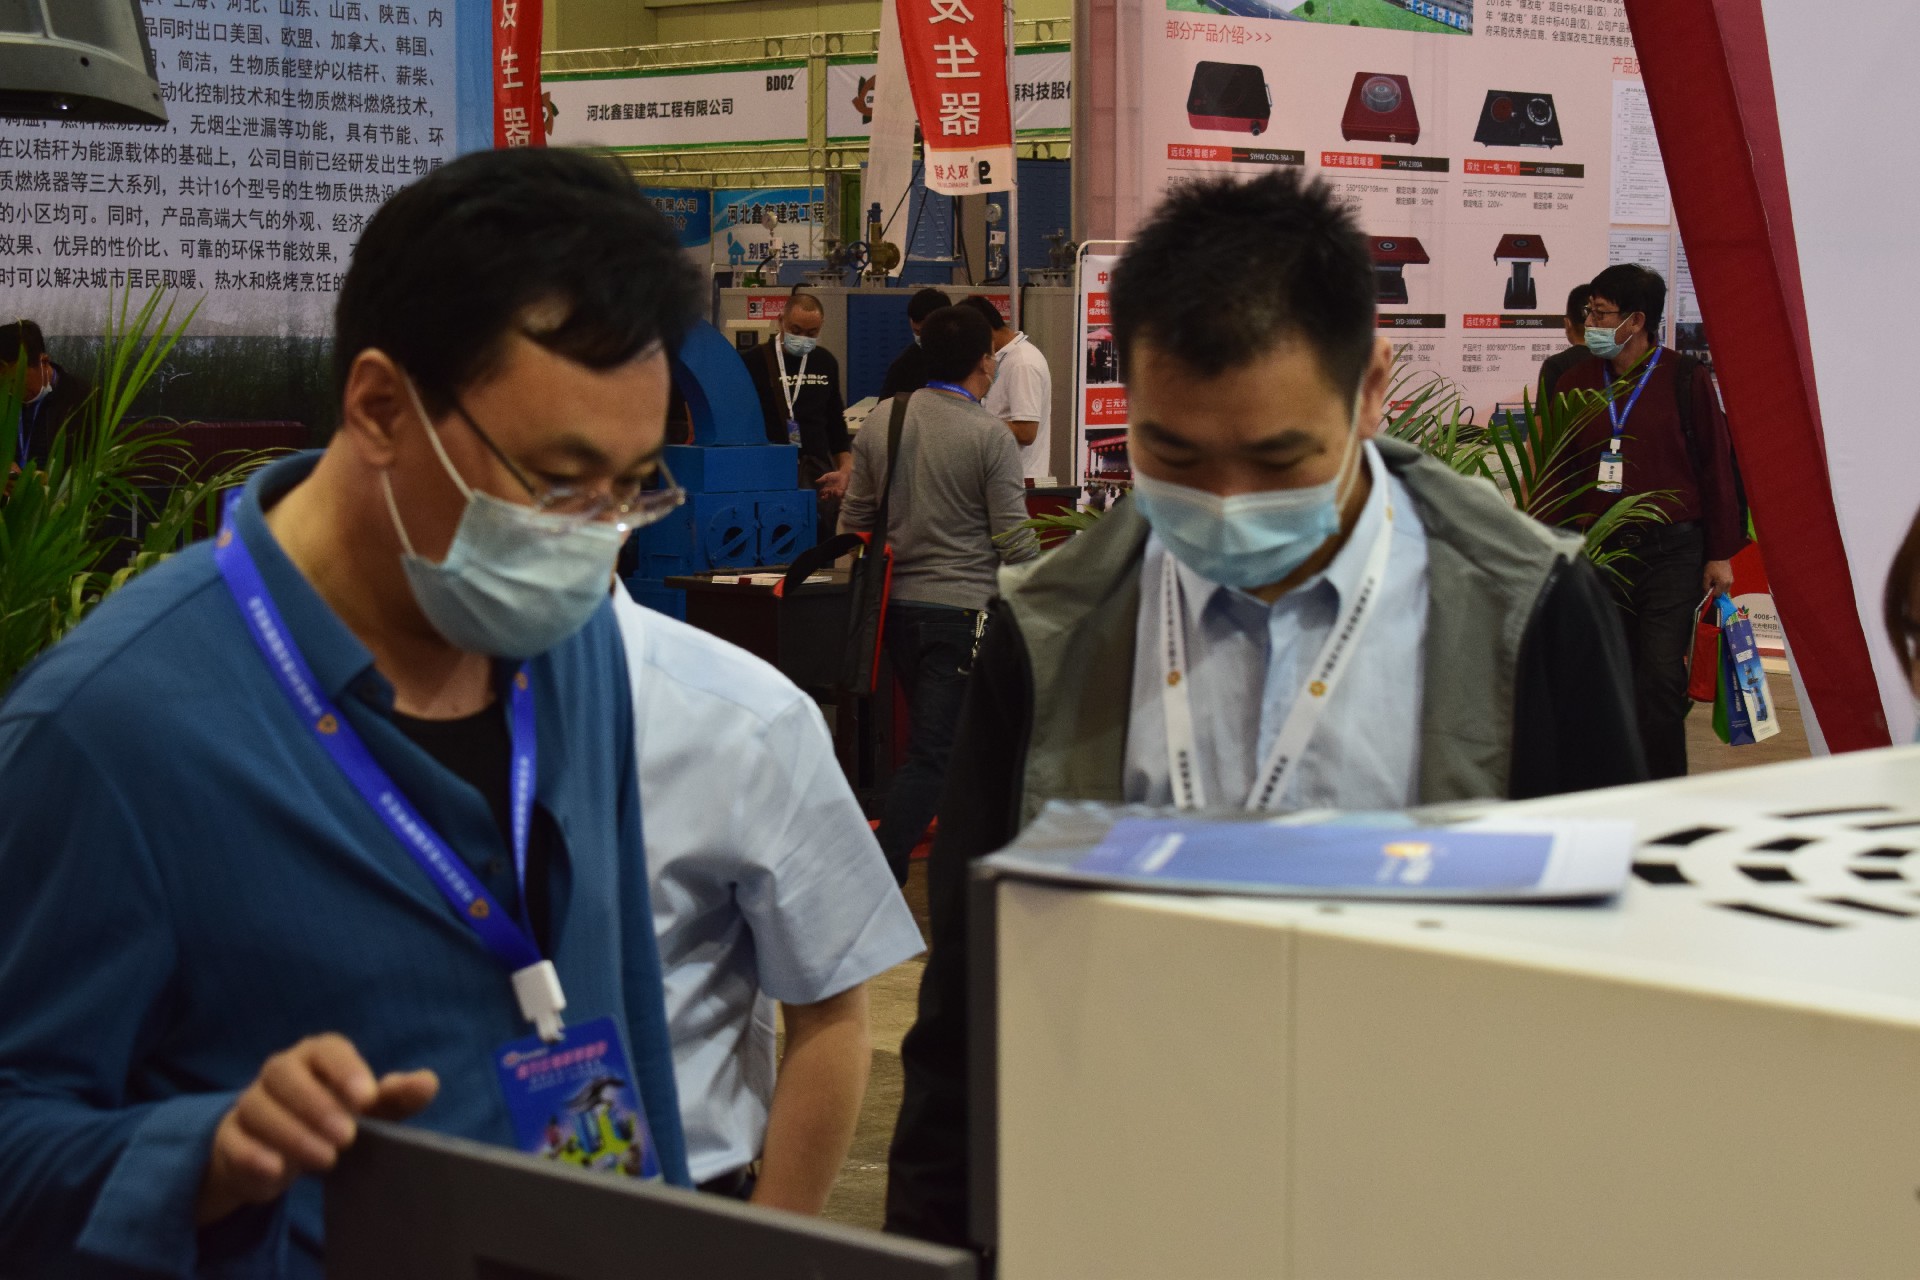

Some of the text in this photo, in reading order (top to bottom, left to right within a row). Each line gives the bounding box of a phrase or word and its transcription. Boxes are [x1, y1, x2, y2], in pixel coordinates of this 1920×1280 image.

[766, 75, 795, 91] BD02
[587, 98, 734, 121] 河北鑫玺建筑工程有限公司
